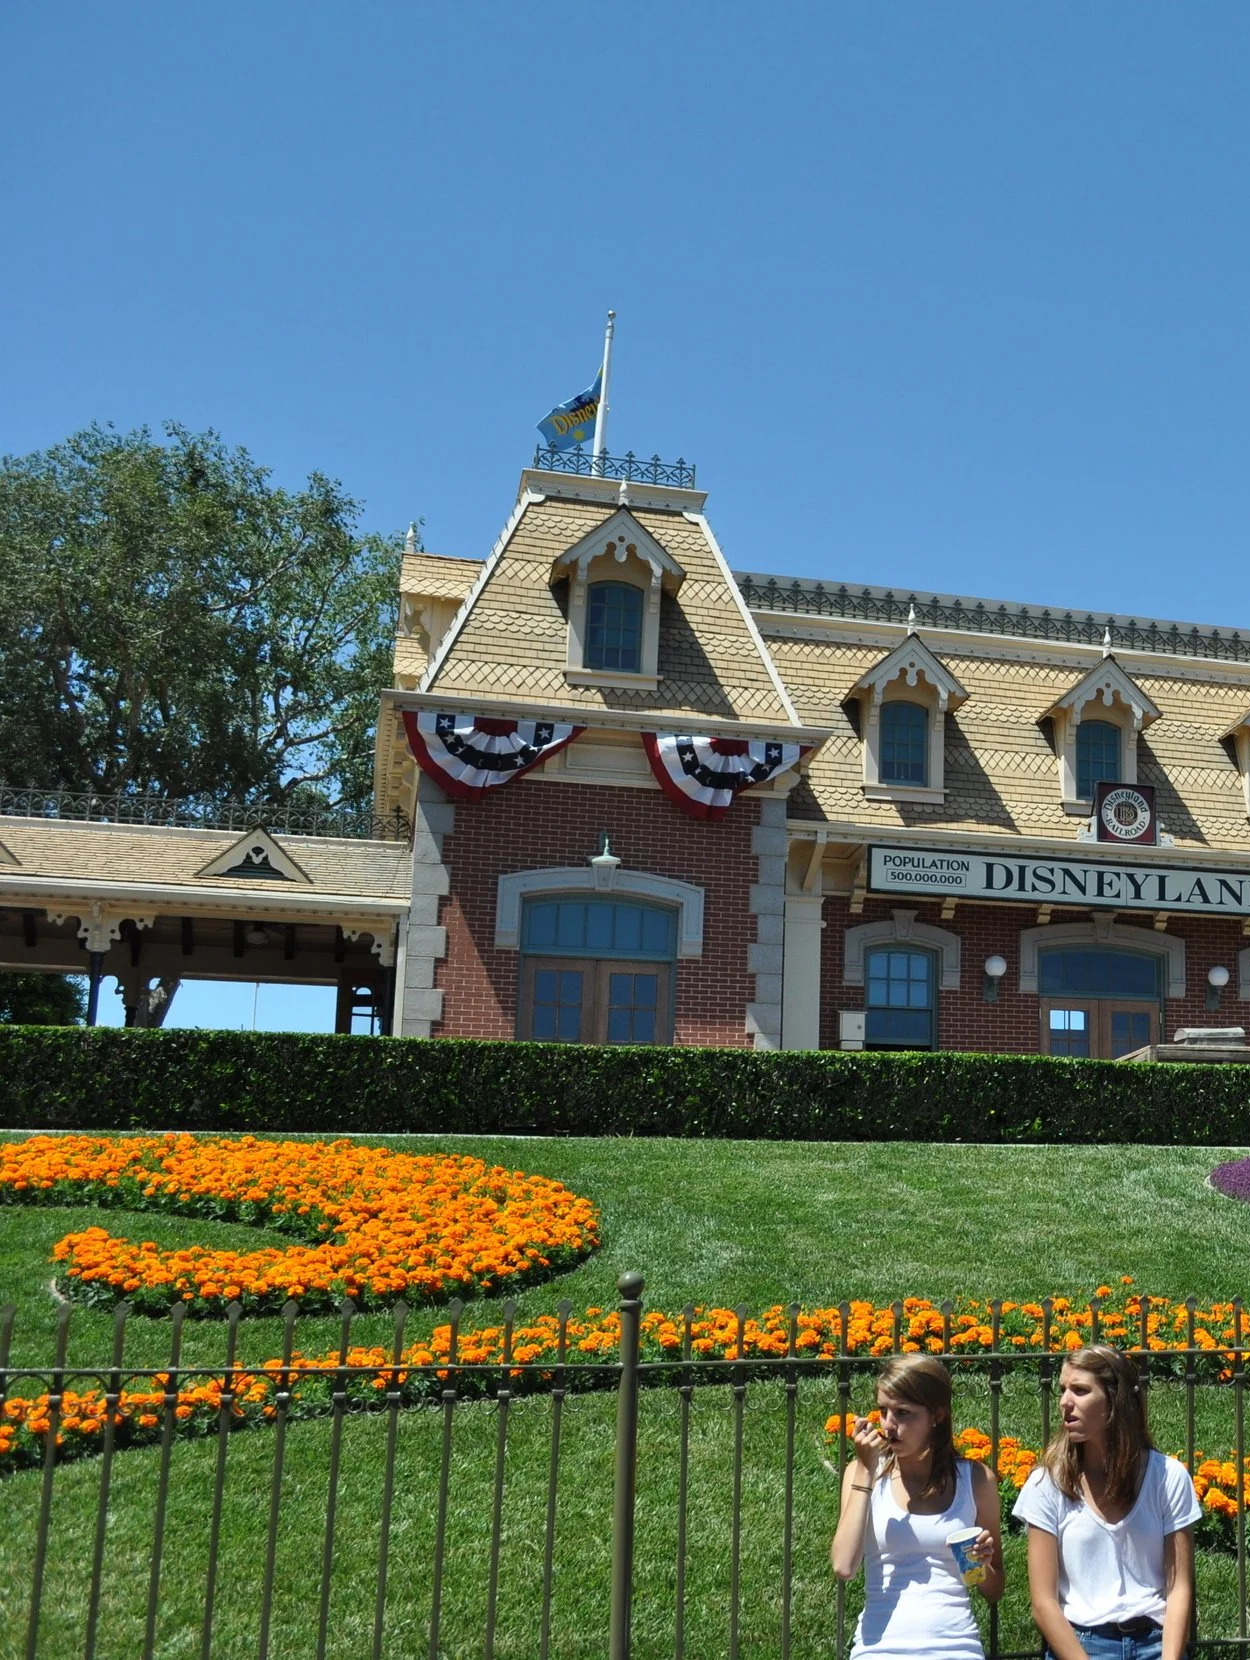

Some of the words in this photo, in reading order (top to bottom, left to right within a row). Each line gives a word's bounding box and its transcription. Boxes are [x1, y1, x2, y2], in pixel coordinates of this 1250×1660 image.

[1103, 791, 1149, 813] Disneyland
[1105, 818, 1146, 837] RAILROAD
[883, 854, 970, 872] POPULATION
[890, 871, 963, 885] 500,000,000
